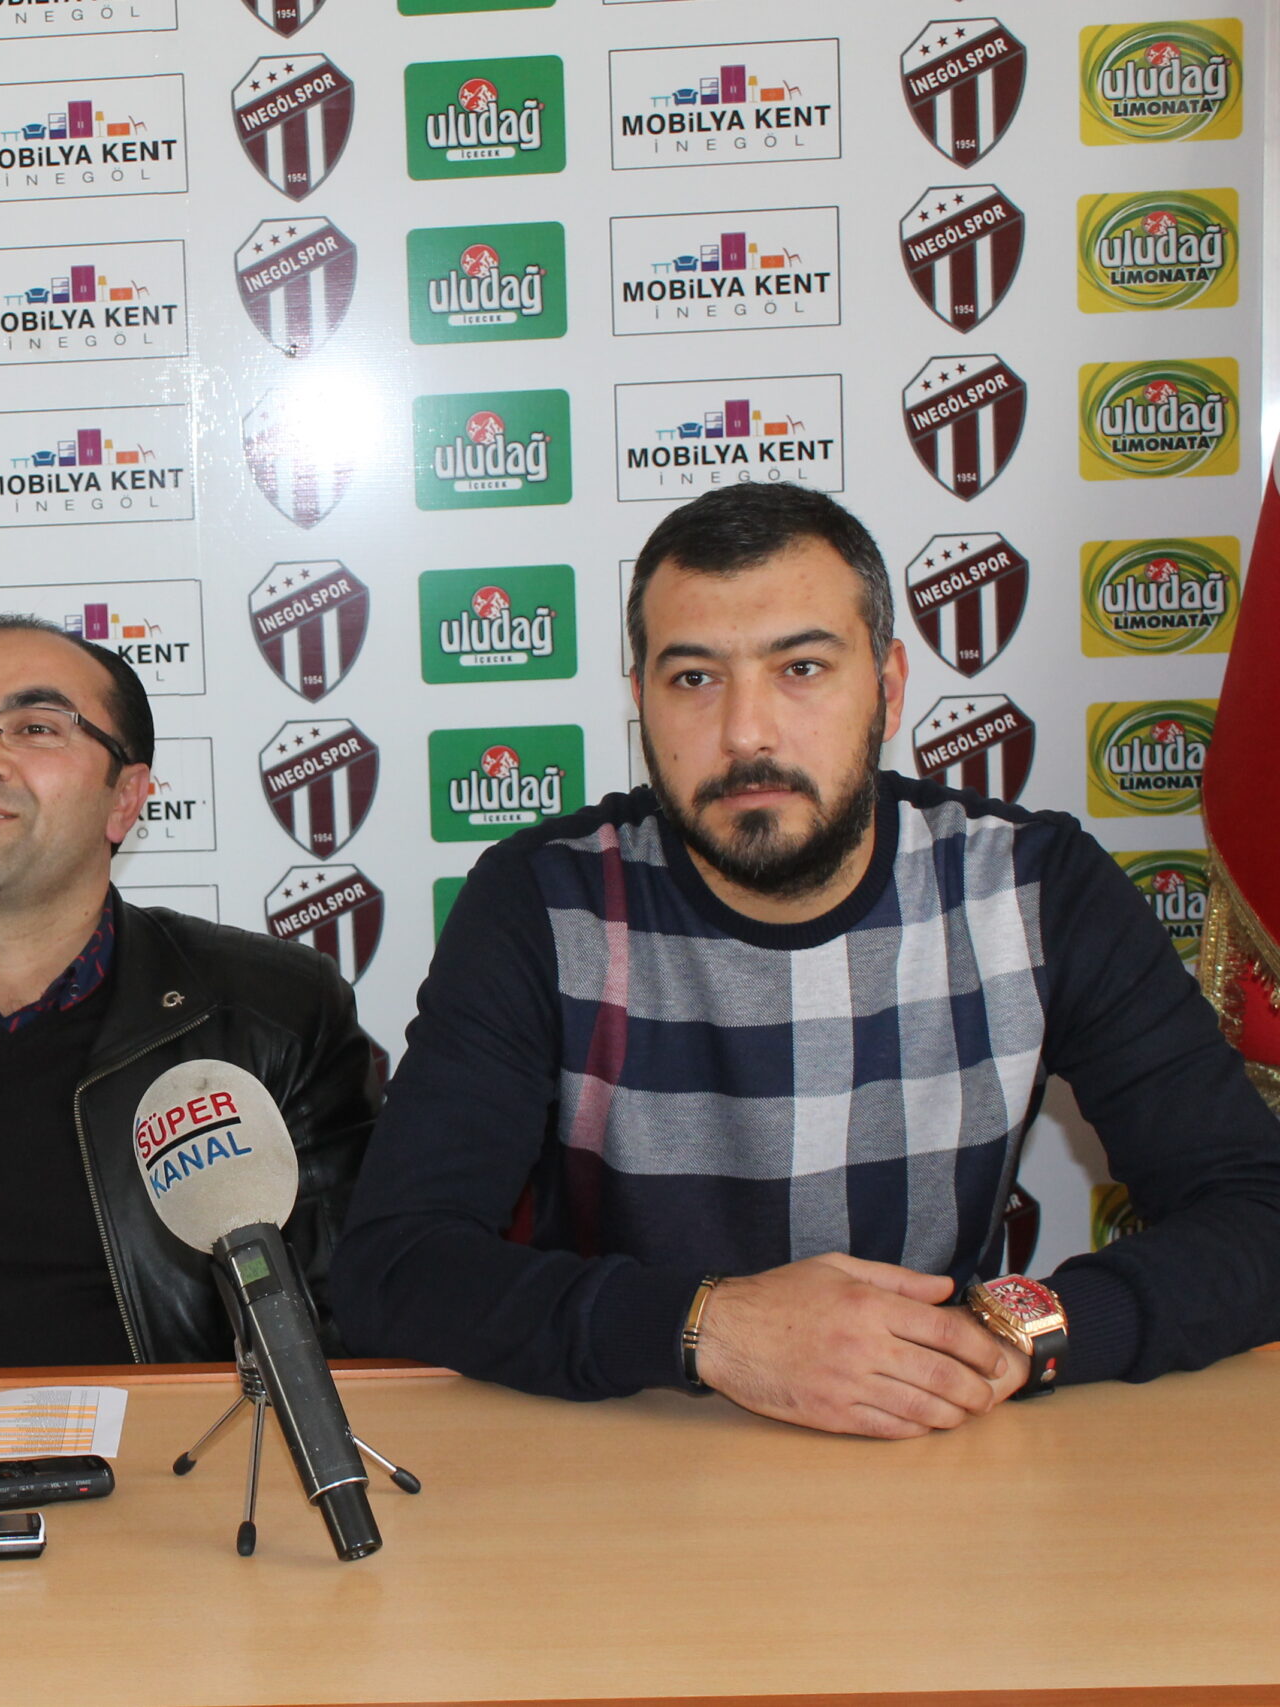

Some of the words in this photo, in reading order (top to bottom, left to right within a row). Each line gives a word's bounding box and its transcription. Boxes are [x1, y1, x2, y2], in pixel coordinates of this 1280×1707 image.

[276, 9, 296, 19] 1954
[910, 36, 1008, 97] İNEGÖLSPOR
[1103, 56, 1228, 101] uludağ
[240, 72, 336, 132] İNEGÖLSPOR
[756, 106, 831, 127] KENT
[426, 98, 543, 151] uludağ
[956, 139, 976, 149] 1954
[102, 140, 177, 163] KENT
[287, 173, 307, 183] 1954
[909, 204, 1006, 263] İNEGÖLSPOR
[1100, 224, 1223, 269] uludağ
[245, 235, 339, 294] İNEGÖLSPOR
[756, 273, 830, 295] KENT
[429, 265, 544, 316] uludağ
[954, 304, 974, 315] 1954
[105, 305, 178, 327] KENT
[911, 374, 1008, 431] İNEGÖLSPOR
[1102, 393, 1224, 436] uludağ
[435, 432, 548, 482] uludağ
[759, 440, 833, 461] KENT
[111, 469, 184, 490] KENT
[957, 473, 977, 482] 1954
[914, 551, 1011, 608] İNEGÖLSPOR
[1103, 572, 1226, 614] uludağ
[258, 579, 352, 634] İNEGÖLSPOR
[440, 607, 553, 656] uludağ
[118, 643, 189, 664] KENT
[960, 649, 980, 659] 1954
[303, 675, 323, 685] 1954
[922, 714, 1017, 769] İNEGÖLSPOR
[1109, 735, 1206, 774] uluda
[268, 738, 362, 793] İNEGÖLSPOR
[1121, 772, 1203, 790] LİMONAT
[137, 801, 196, 821] ENT
[449, 766, 562, 815] uludağ
[313, 833, 333, 842] 1954
[273, 883, 366, 938] İNEGÖLSPOR
[138, 1092, 238, 1159] SÜPER
[150, 1131, 252, 1199] KANAL
